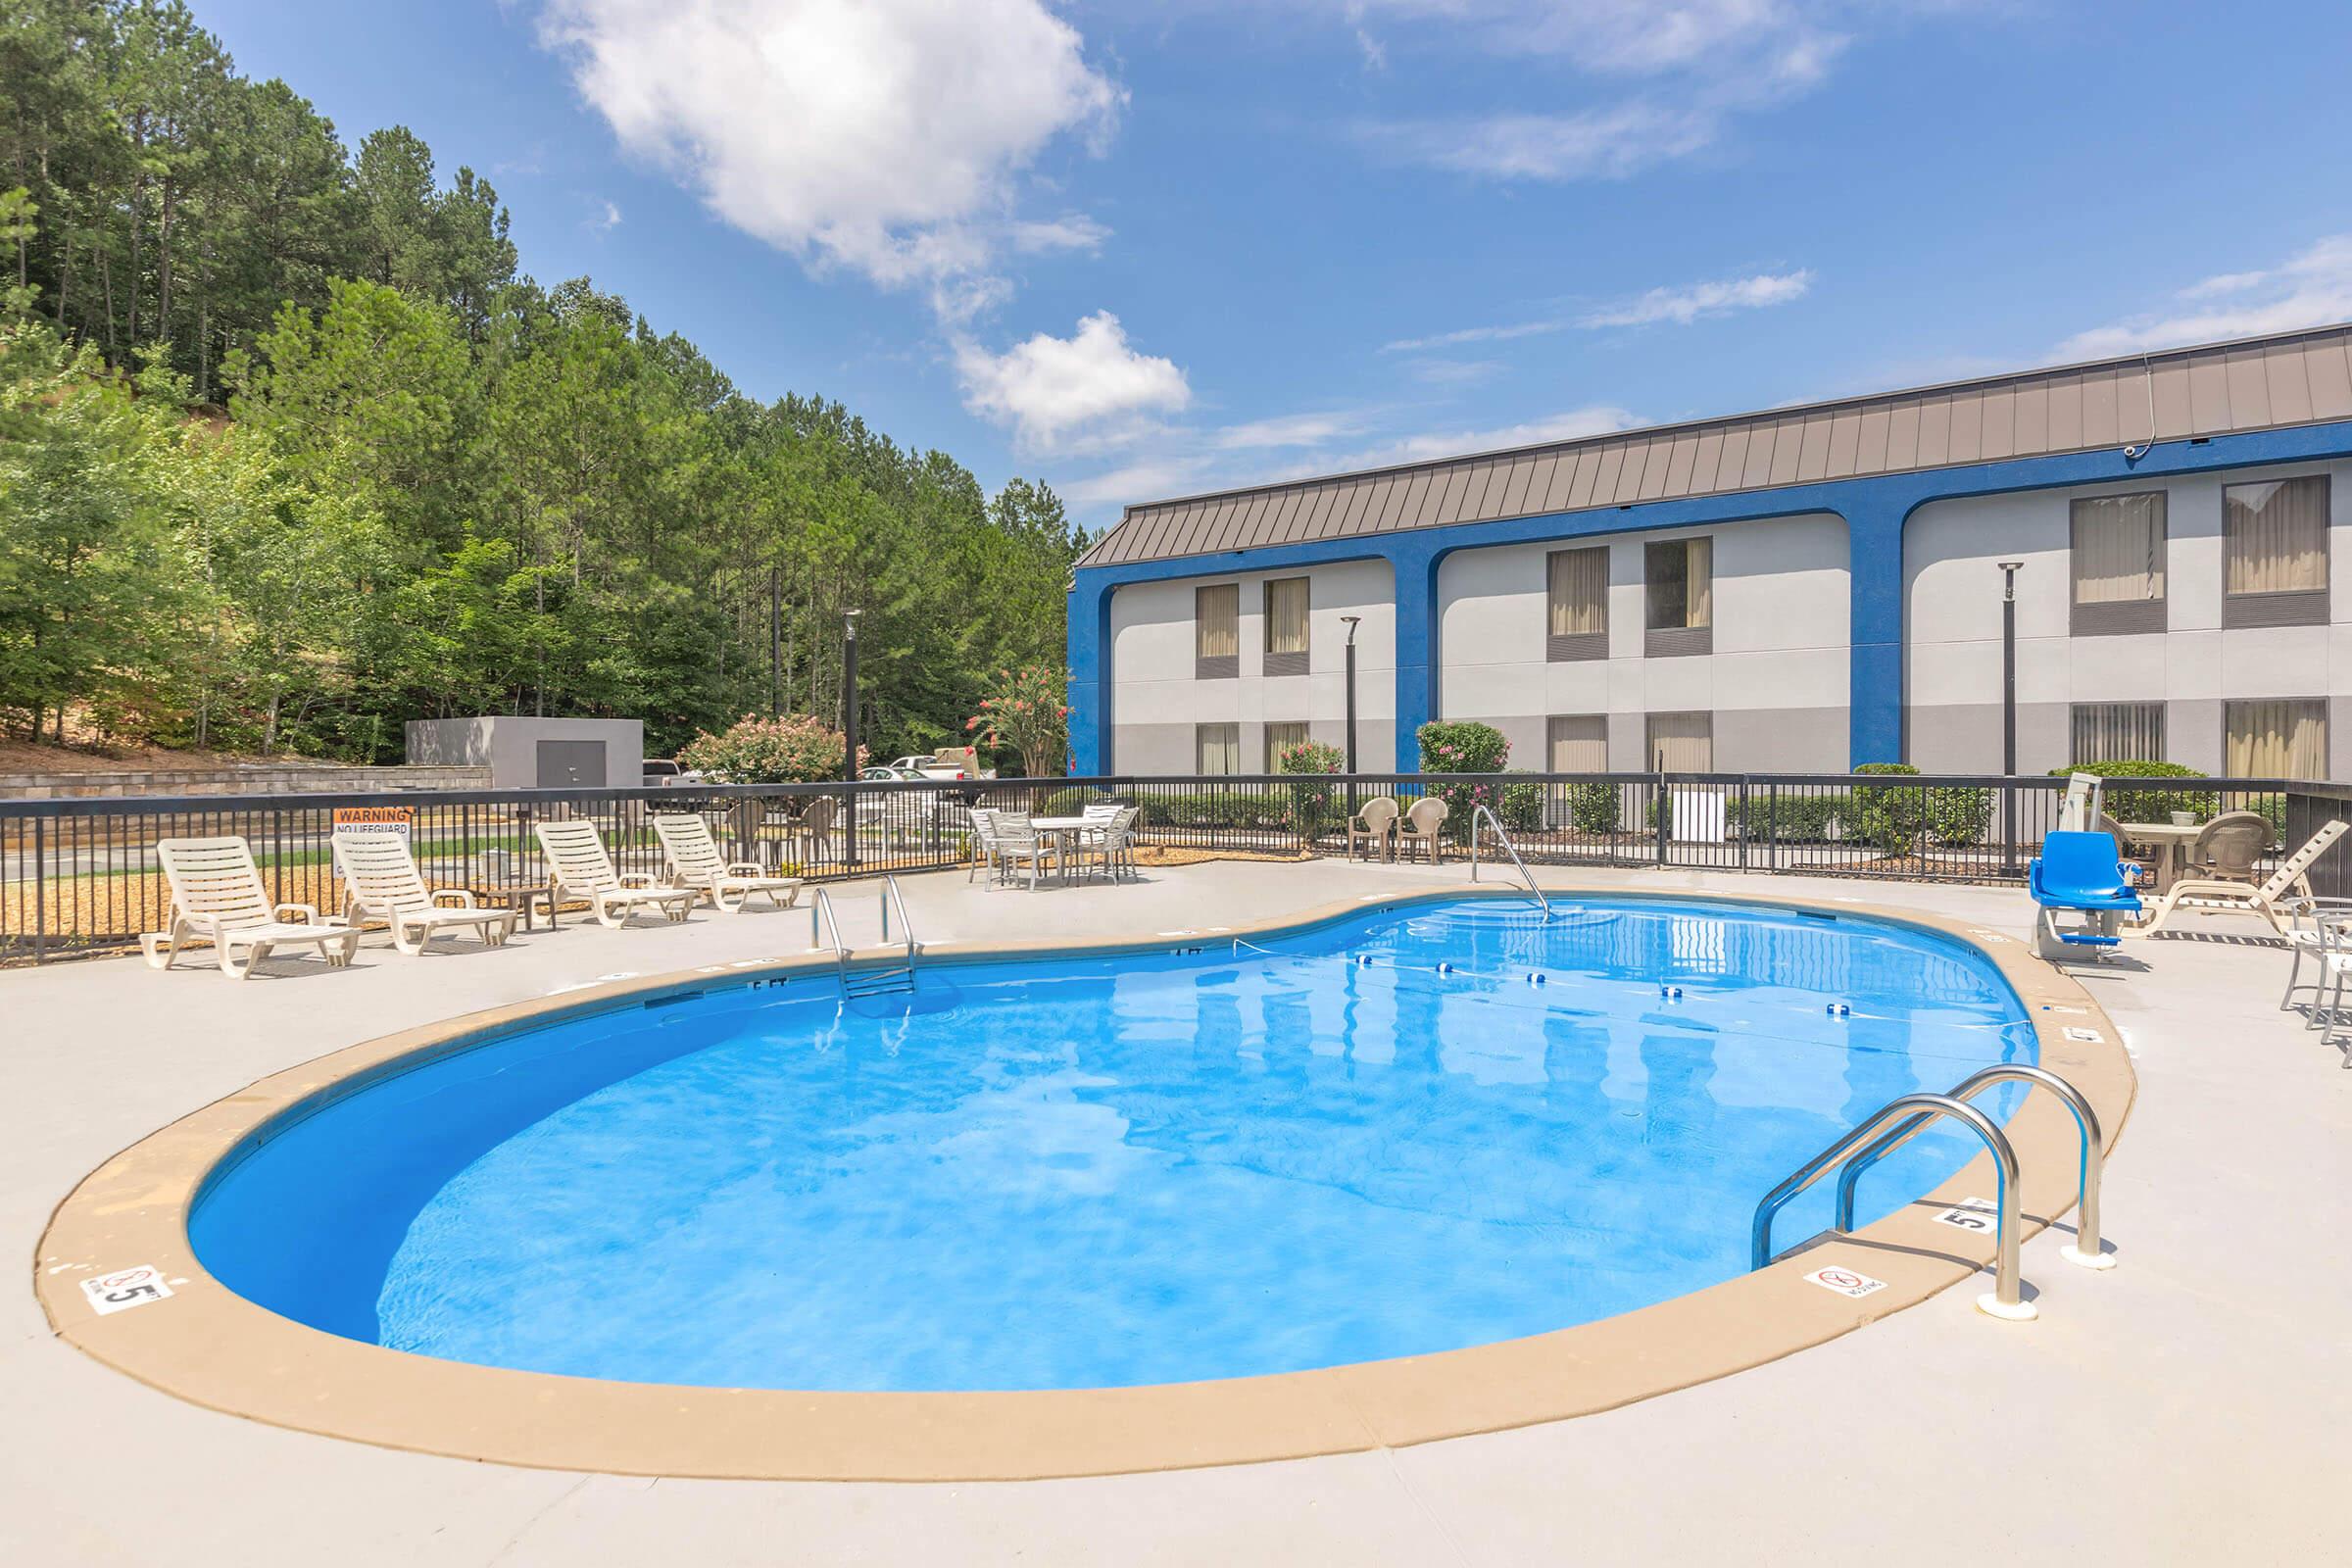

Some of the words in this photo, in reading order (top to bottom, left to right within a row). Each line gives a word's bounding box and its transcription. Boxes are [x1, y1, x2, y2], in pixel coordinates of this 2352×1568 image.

[340, 809, 406, 821] WARNING
[337, 824, 352, 833] NO
[354, 824, 408, 834] LIFEGUARD
[1944, 1214, 1985, 1229] 5
[105, 1284, 157, 1303] 5
